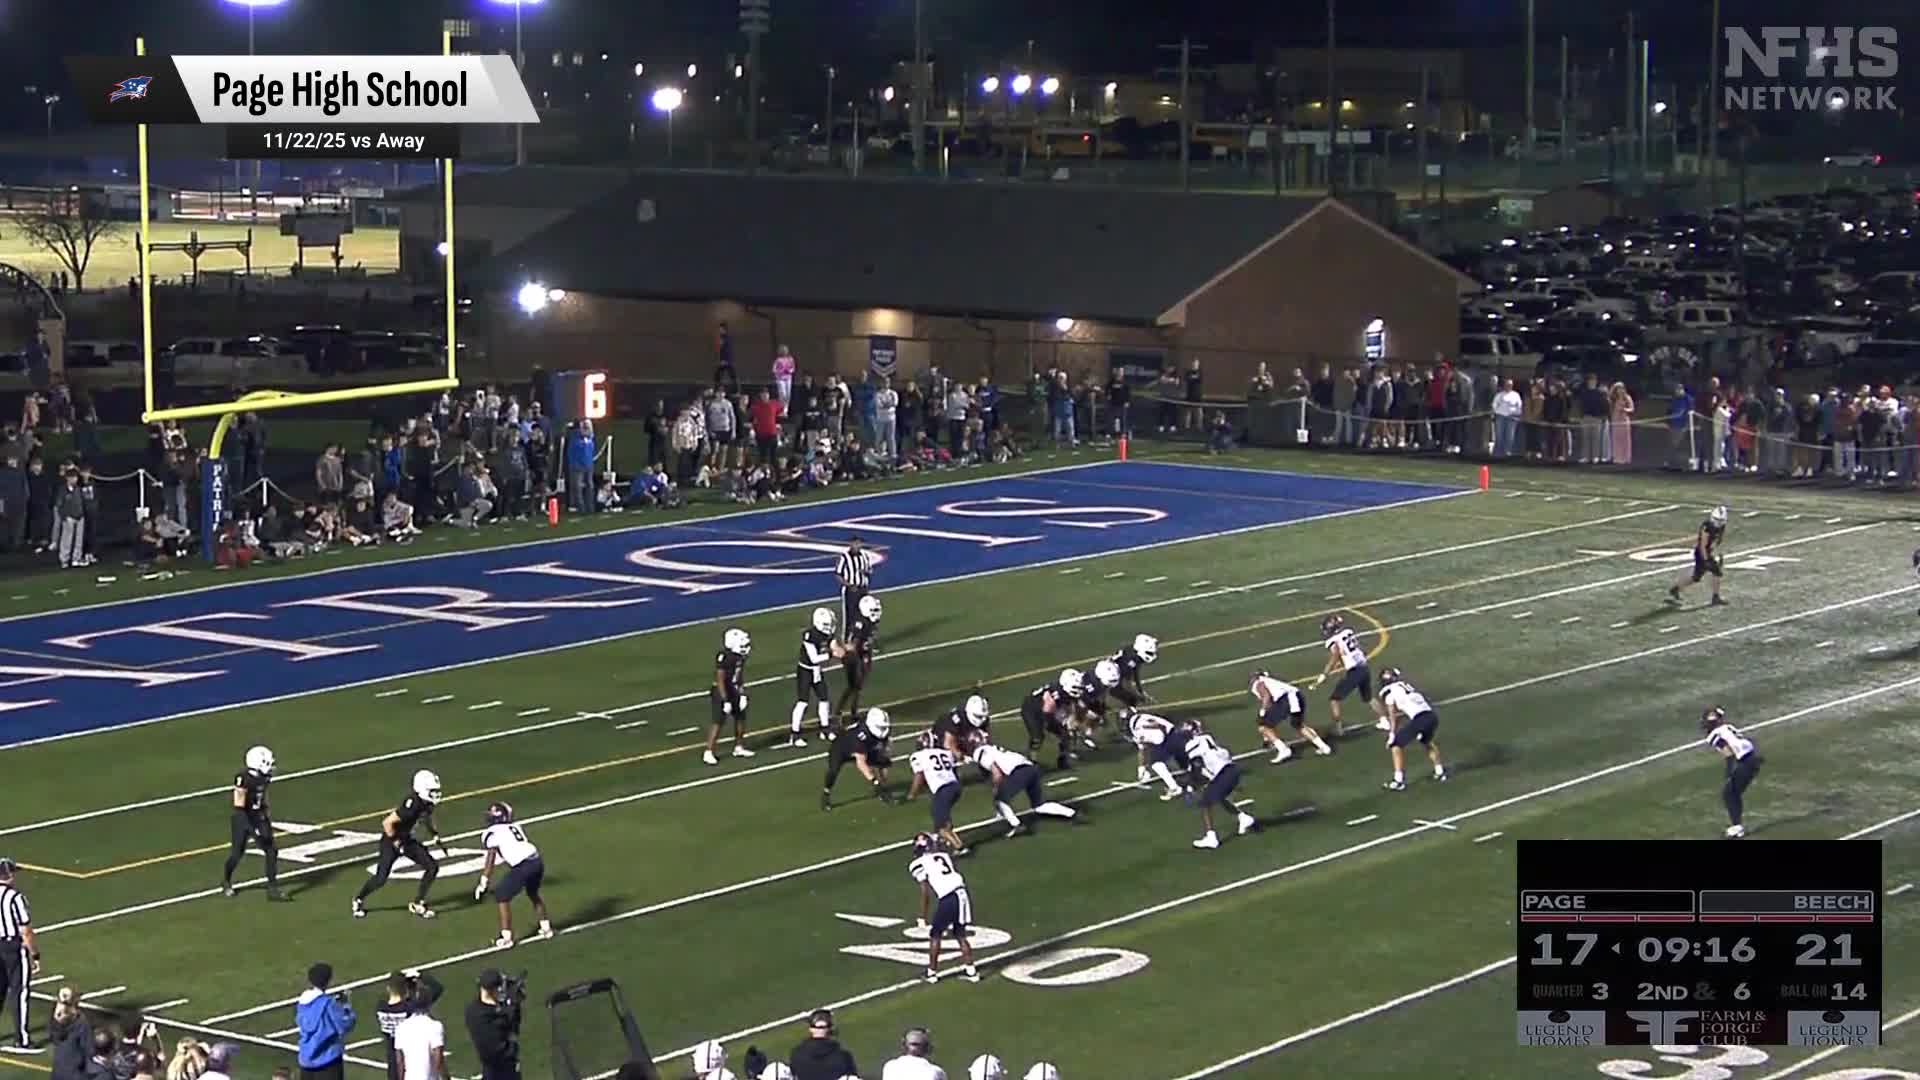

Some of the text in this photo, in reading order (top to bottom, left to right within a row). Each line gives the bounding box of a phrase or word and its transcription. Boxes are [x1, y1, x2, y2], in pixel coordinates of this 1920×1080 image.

[584, 373, 607, 419] 6
[212, 464, 223, 532] PATRI
[928, 752, 953, 772] 36
[508, 825, 525, 842] 8
[932, 855, 953, 876] 3
